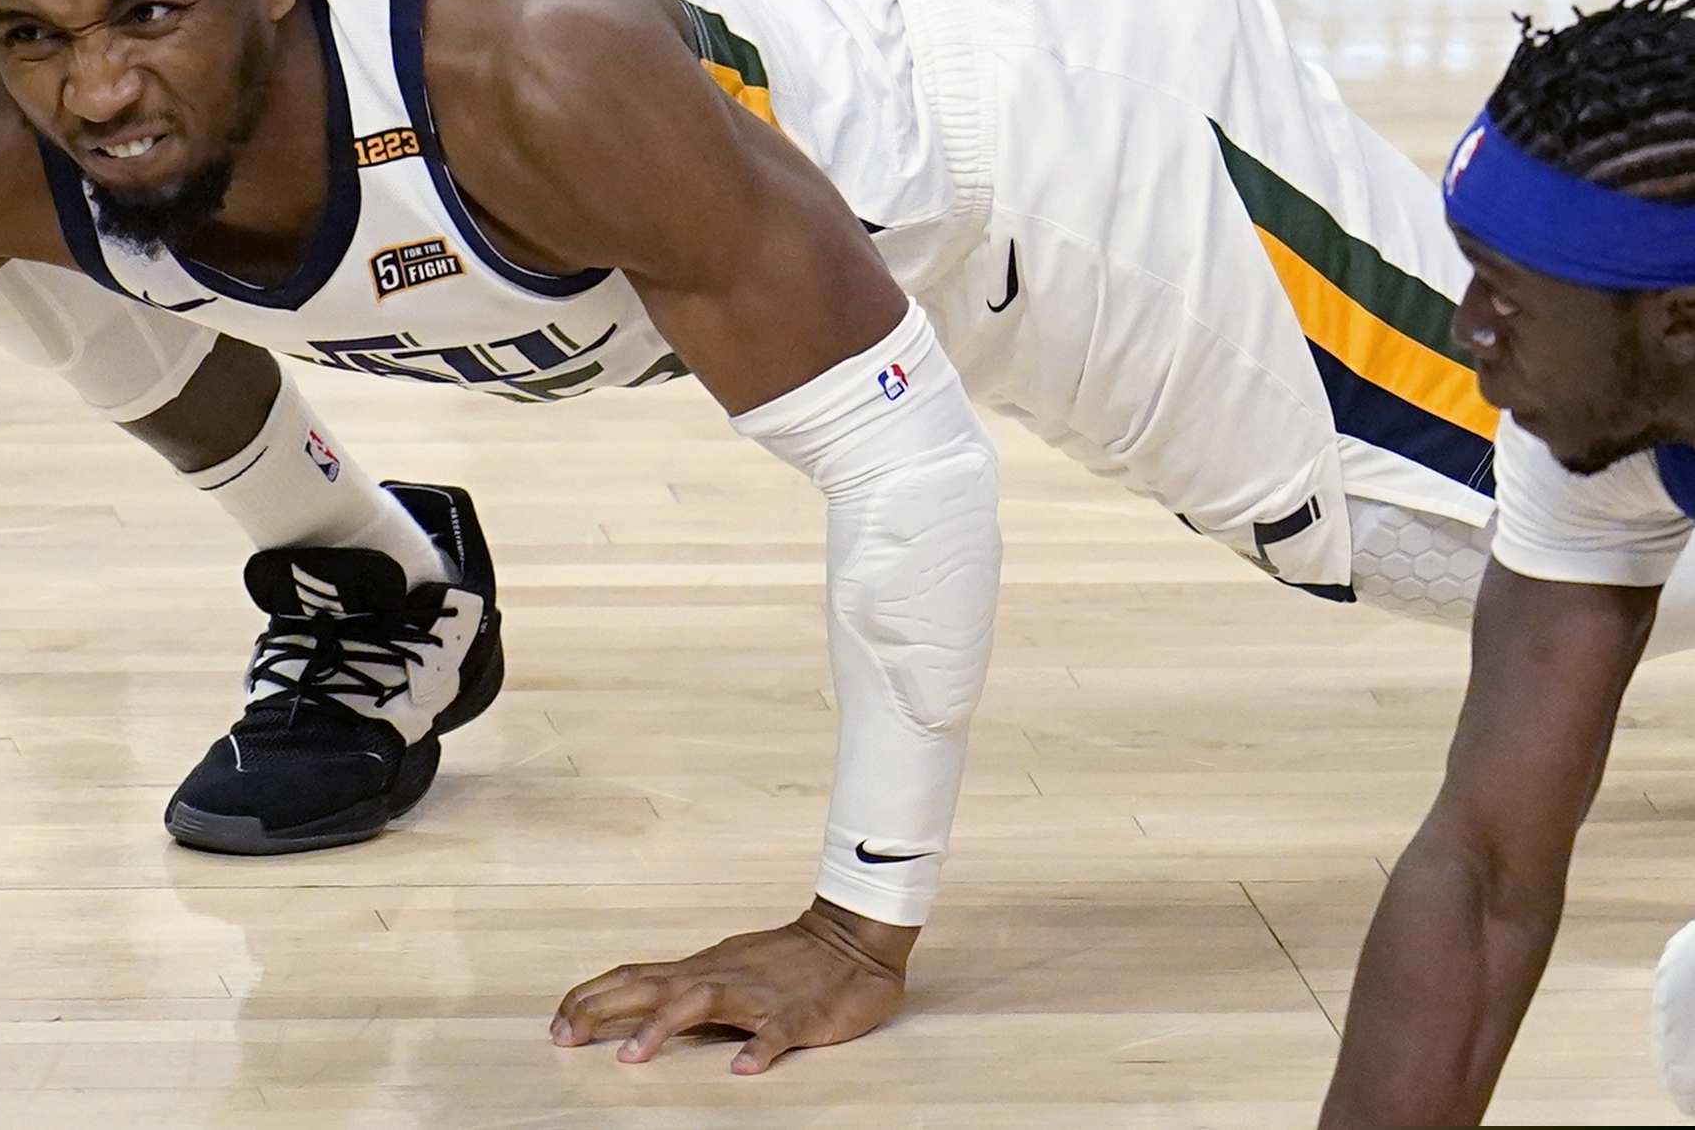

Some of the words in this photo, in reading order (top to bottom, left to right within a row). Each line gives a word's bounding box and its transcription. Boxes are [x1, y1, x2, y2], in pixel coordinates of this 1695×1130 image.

[354, 130, 420, 166] 1223
[404, 246, 424, 259] FOR
[424, 242, 442, 255] THE
[376, 253, 400, 290] 5
[408, 257, 457, 283] FIGHT
